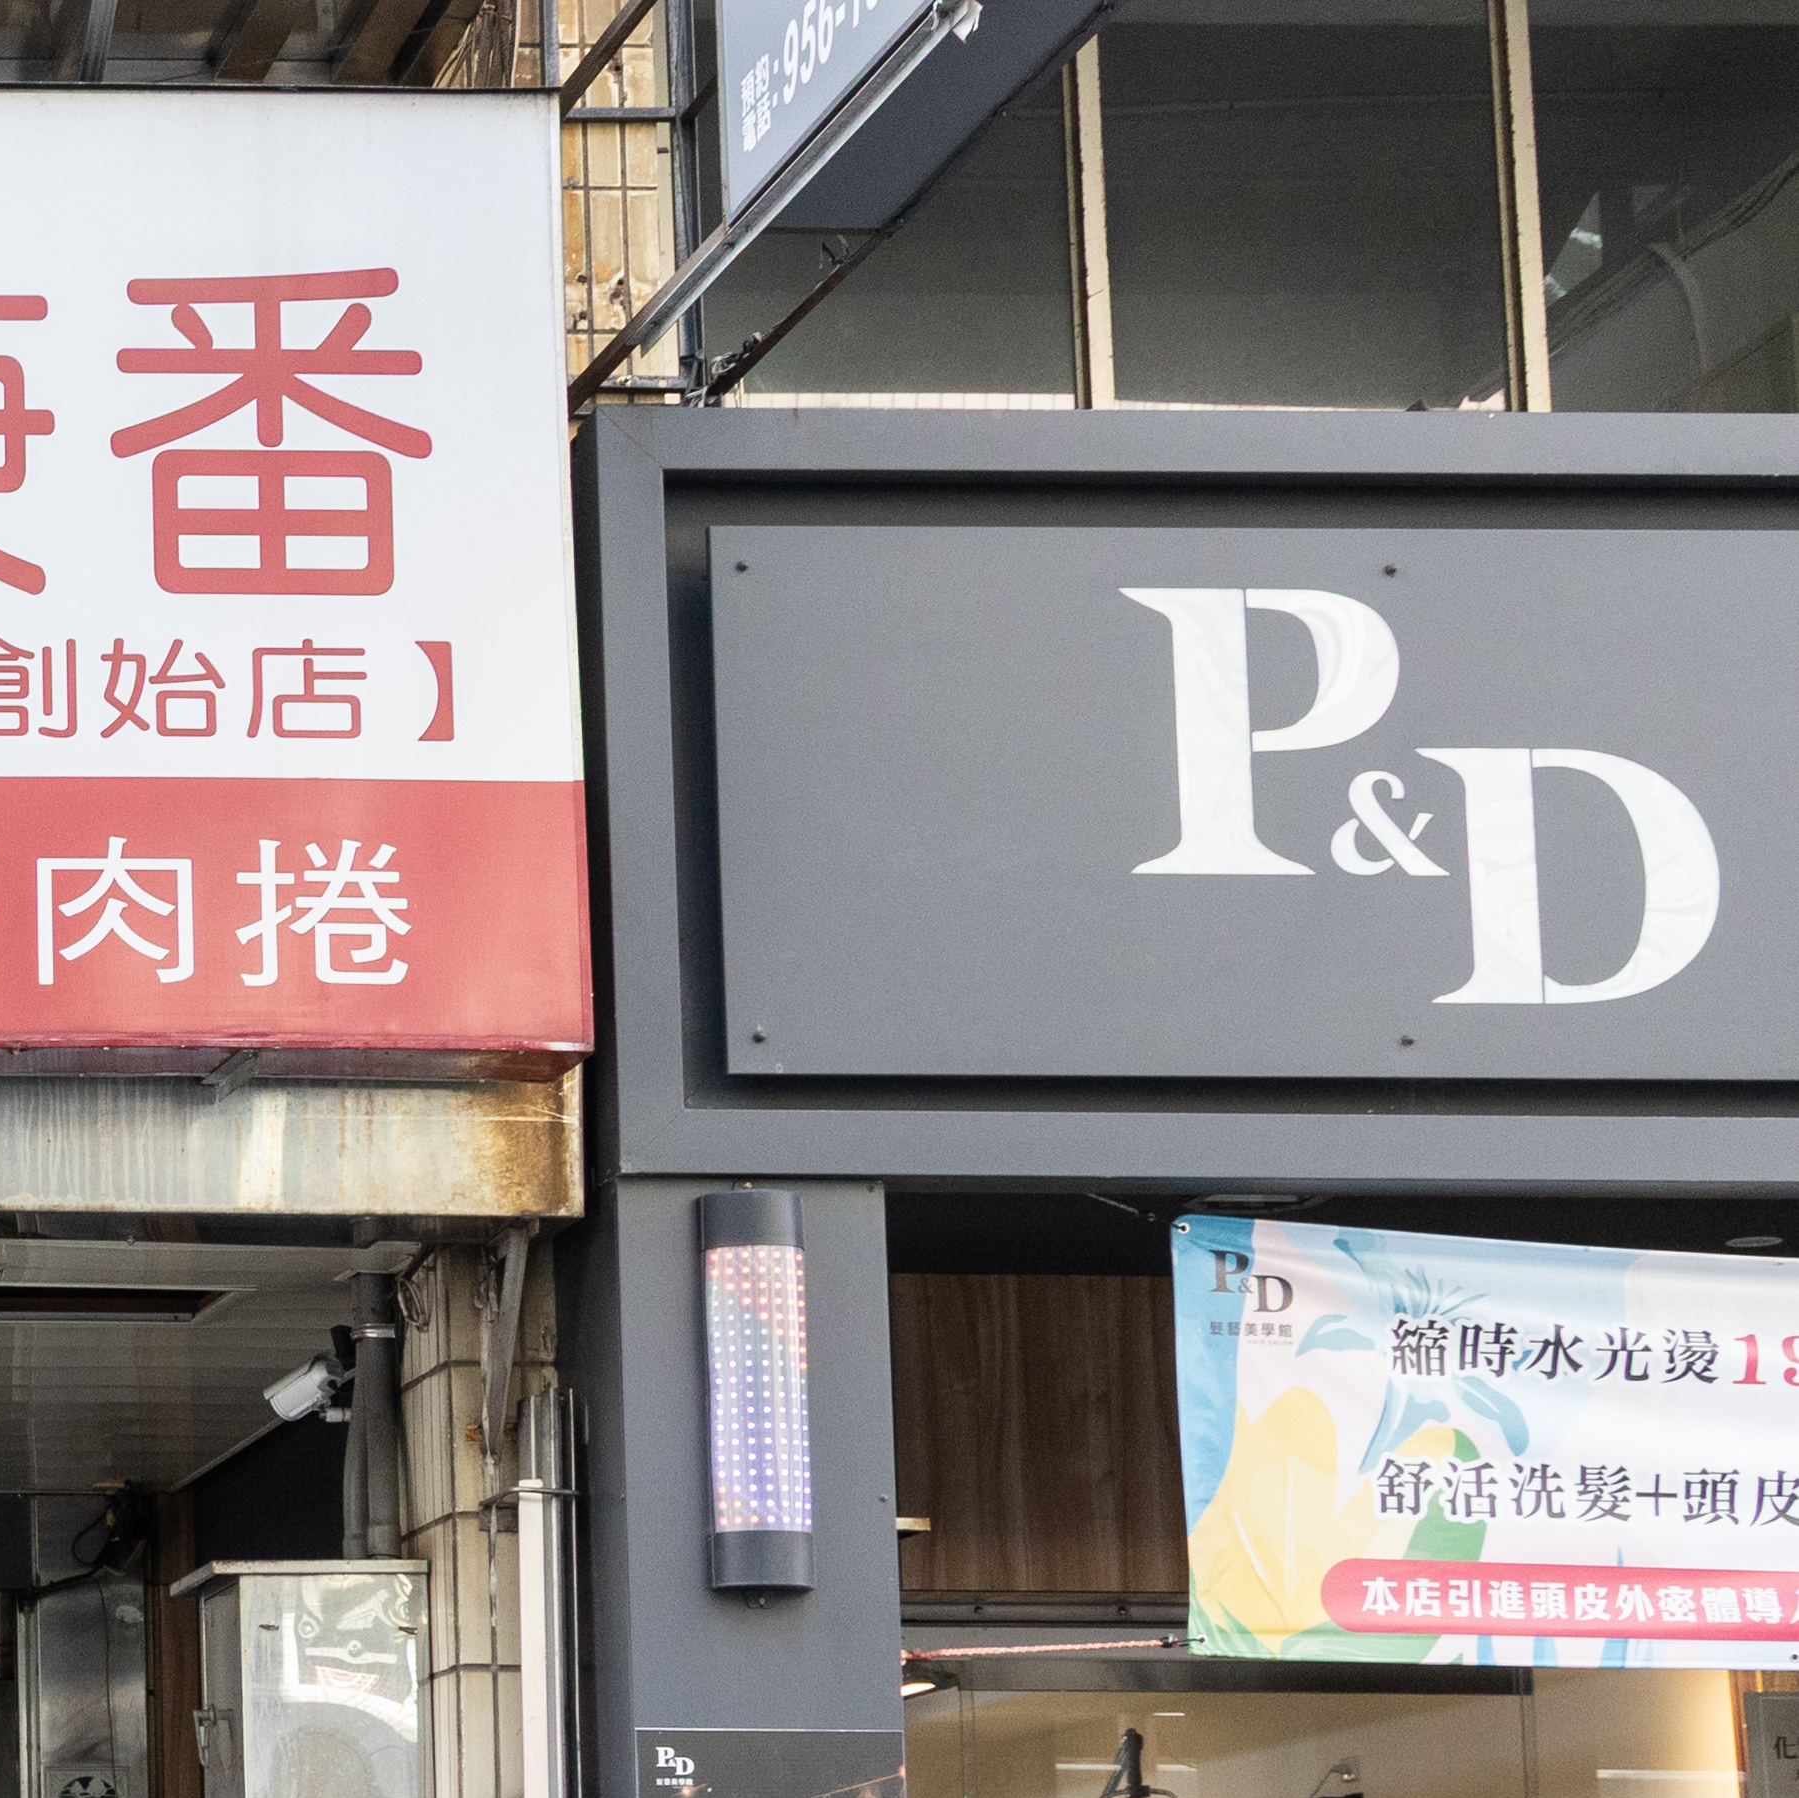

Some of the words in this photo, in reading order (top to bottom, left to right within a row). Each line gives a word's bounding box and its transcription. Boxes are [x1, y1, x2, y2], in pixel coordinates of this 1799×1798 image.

[1361, 1577, 1799, 1625] 本店引進頭皮外密體導
